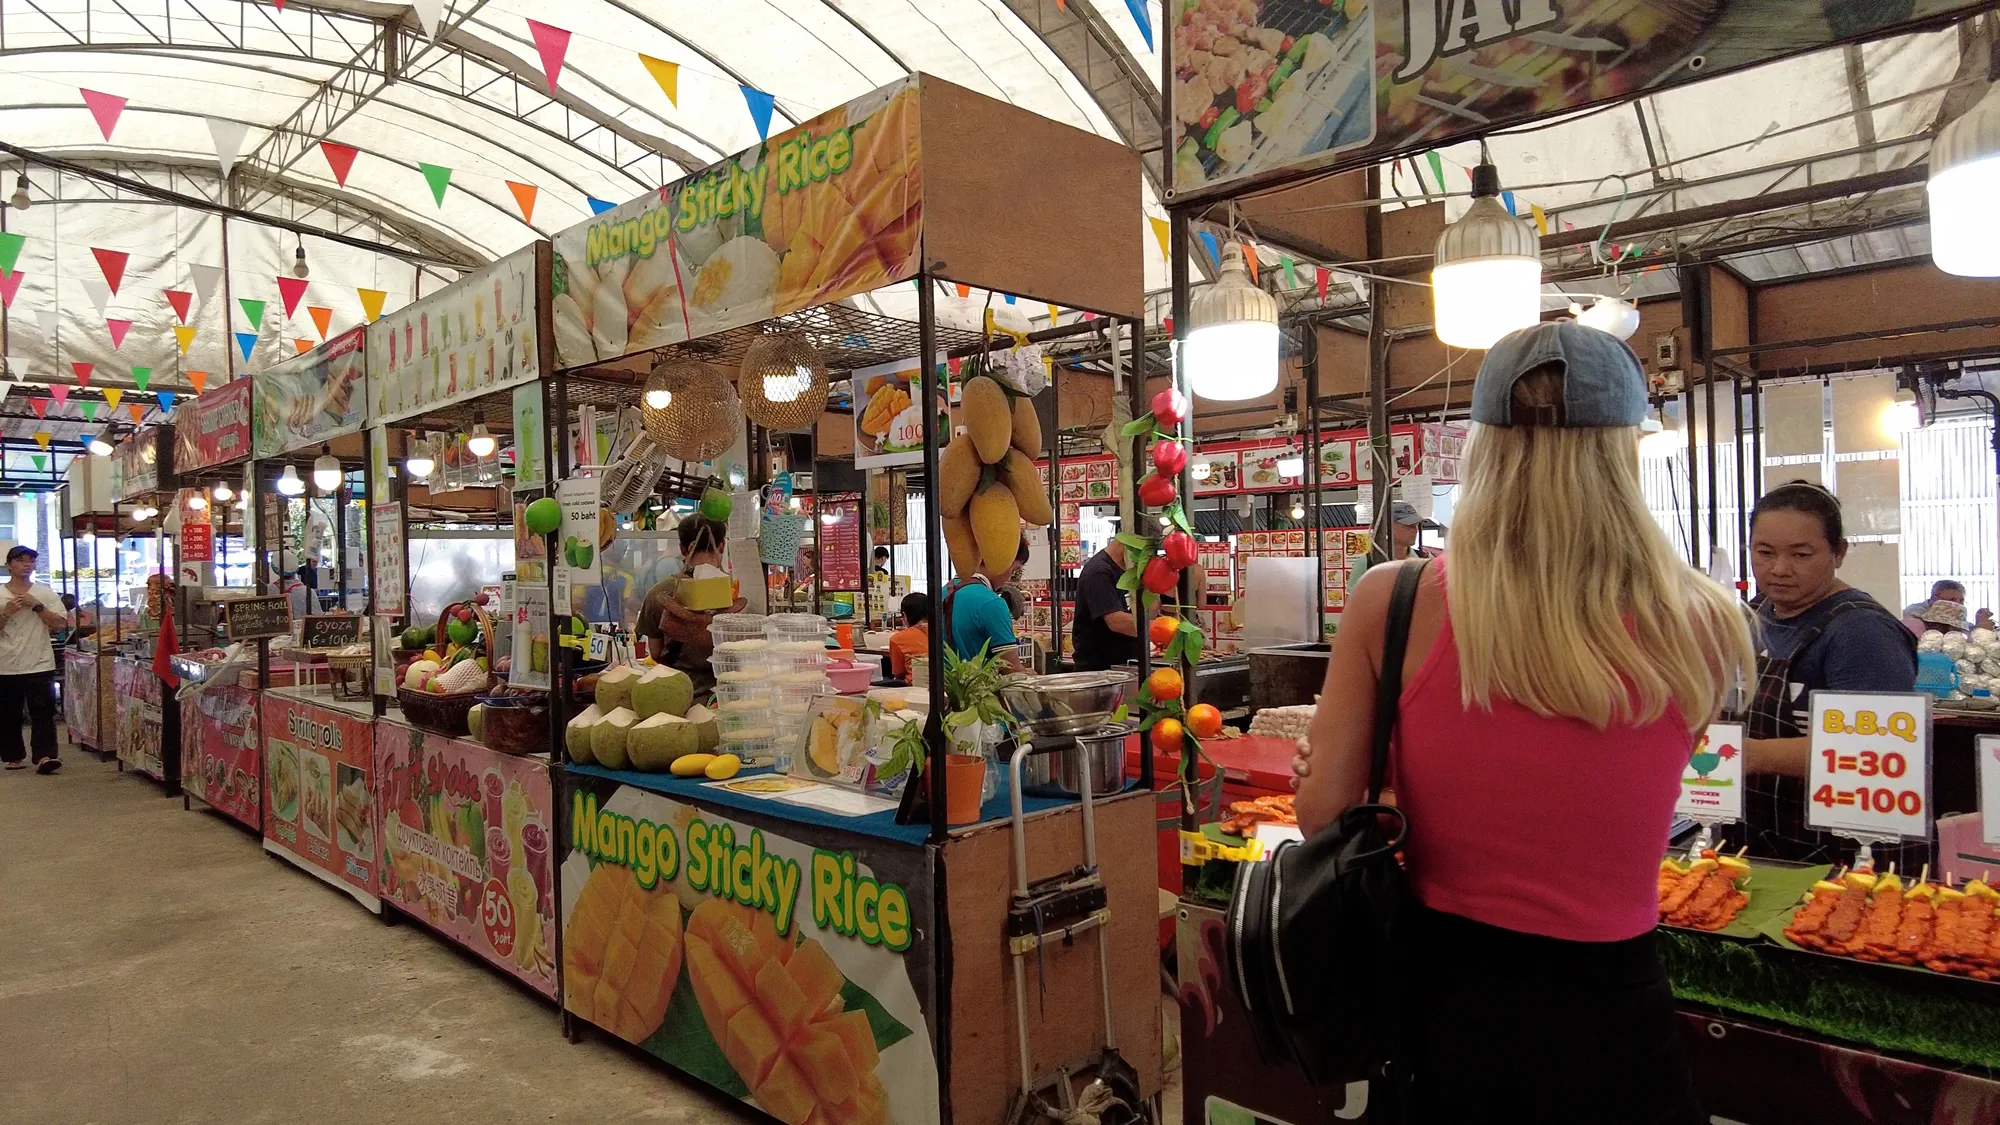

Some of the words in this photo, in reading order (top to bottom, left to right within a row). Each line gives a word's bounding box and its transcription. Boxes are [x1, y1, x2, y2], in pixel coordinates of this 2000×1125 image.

[585, 204, 671, 267] Mango
[674, 161, 768, 232] Sticky
[776, 127, 853, 195] Rice
[571, 512, 579, 521] 50
[581, 511, 596, 520] baht
[234, 602, 265, 613] SPRING
[268, 600, 288, 610] ROLL
[316, 621, 352, 634] GYOZA
[591, 637, 604, 654] 50
[1822, 709, 1918, 743] B.B.Q
[1821, 749, 1907, 779] 1=30
[1812, 784, 1922, 816] 4=100
[572, 789, 679, 889] Mango
[686, 818, 801, 936] Sticky
[811, 847, 912, 951] Rice
[485, 890, 511, 928] 50
